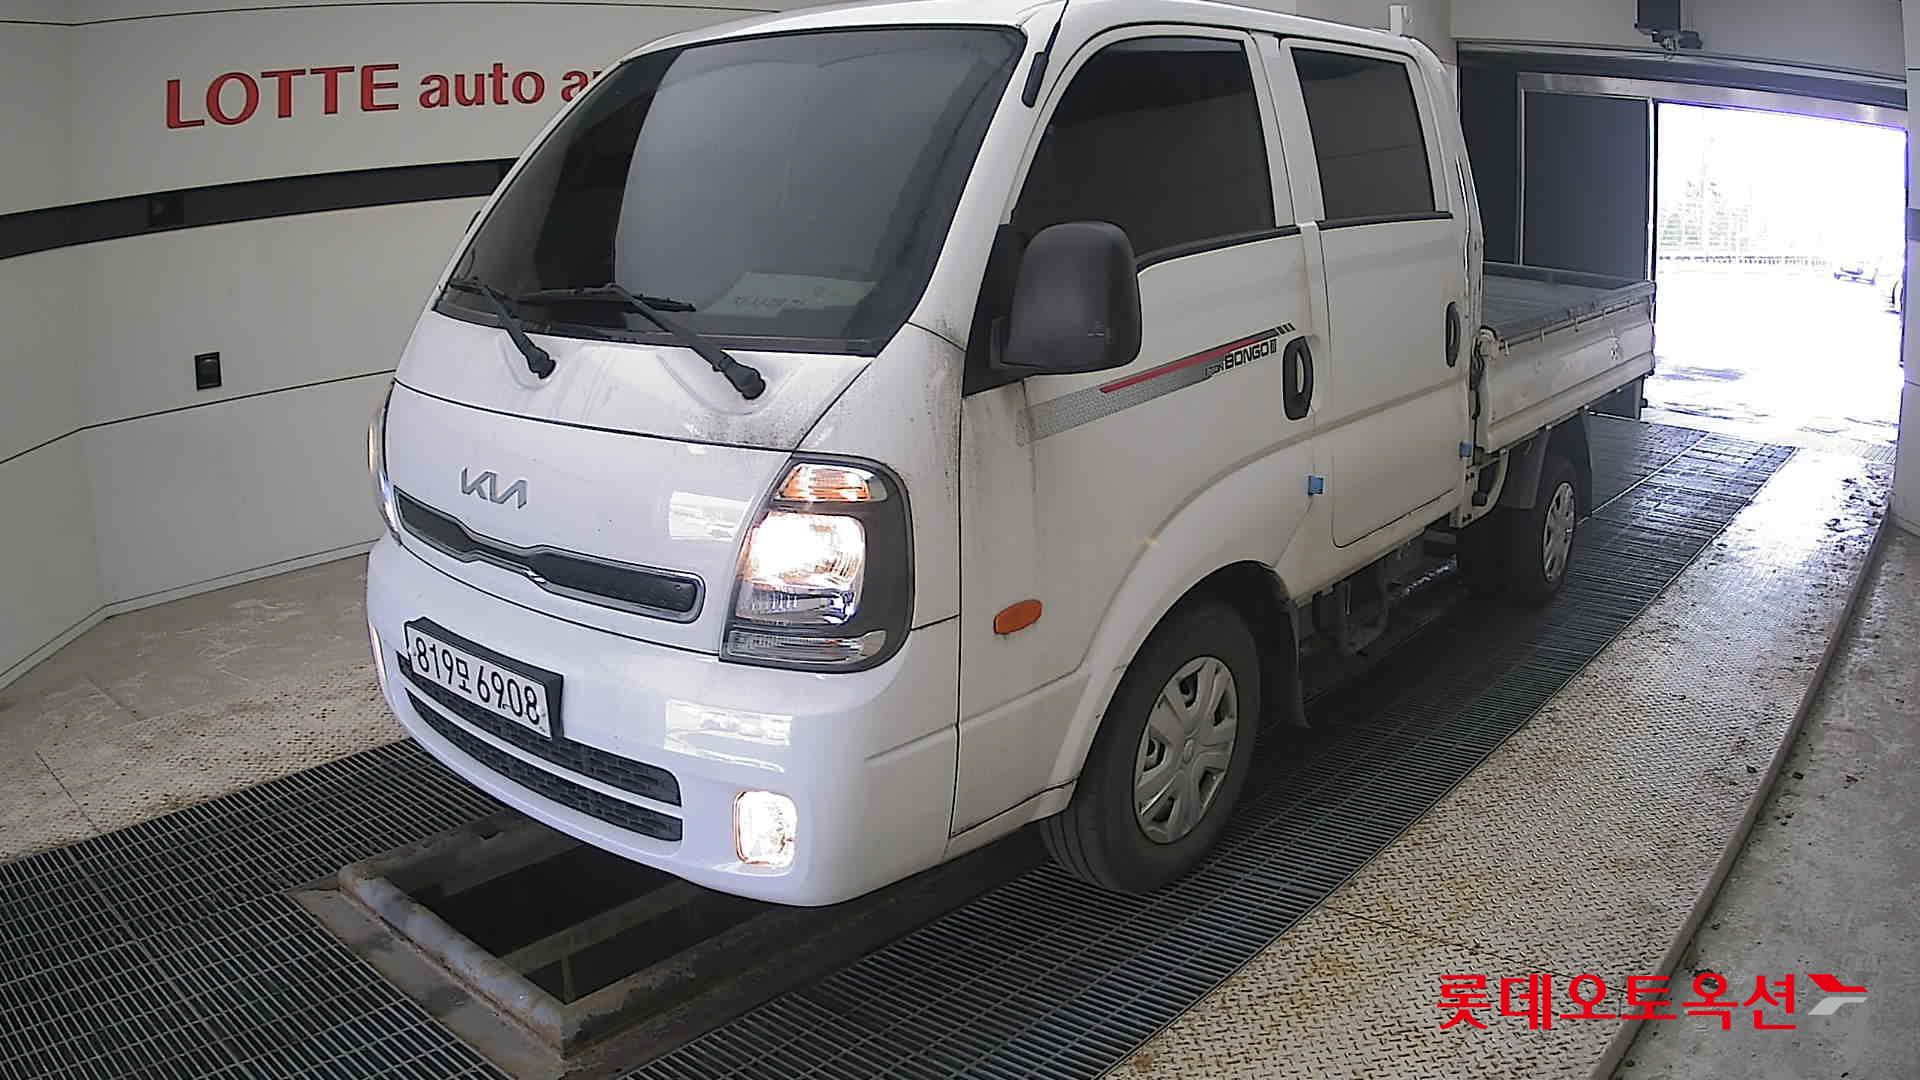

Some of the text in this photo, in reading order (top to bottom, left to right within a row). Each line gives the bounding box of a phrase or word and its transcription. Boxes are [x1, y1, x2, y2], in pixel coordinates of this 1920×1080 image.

[166, 63, 602, 129] LOTTE auto a
[1225, 342, 1269, 370] BONGO
